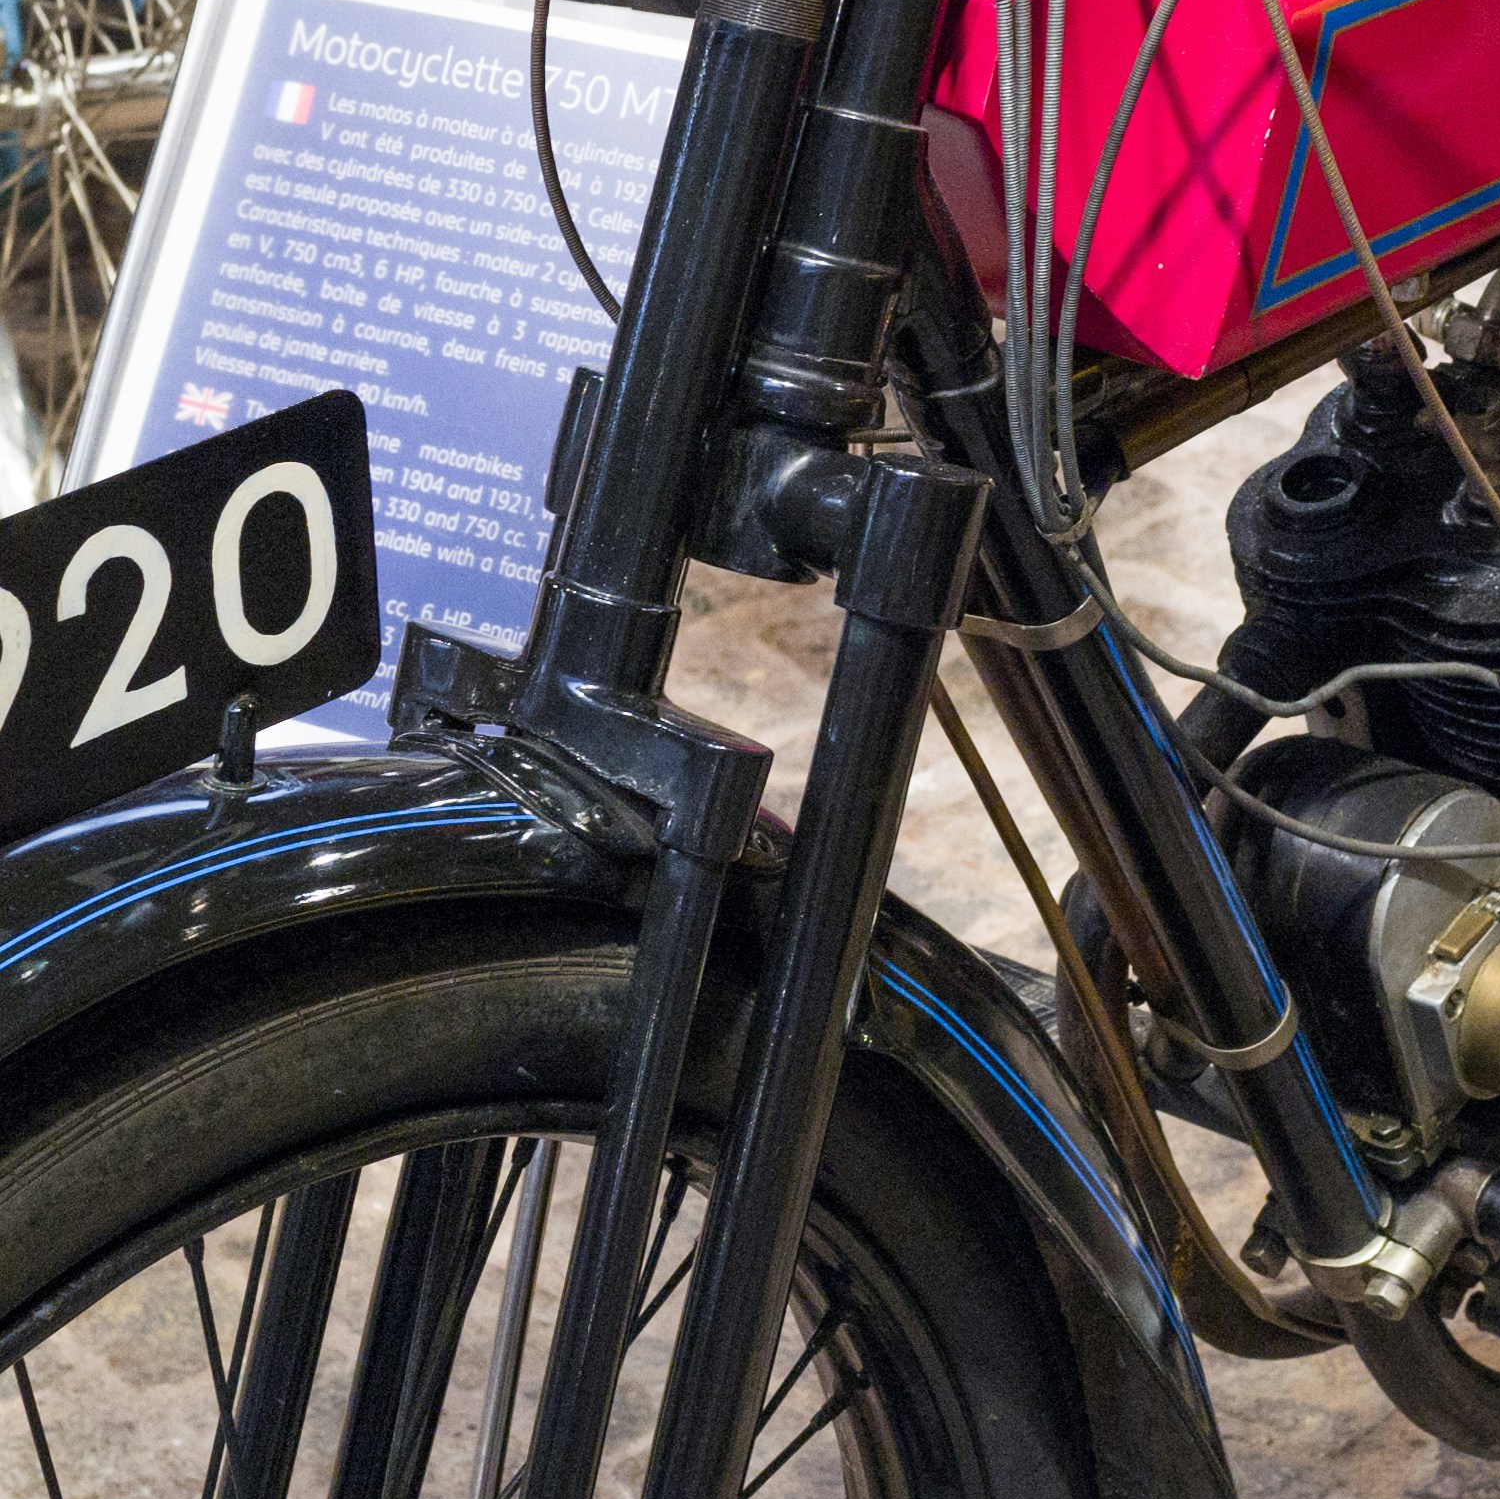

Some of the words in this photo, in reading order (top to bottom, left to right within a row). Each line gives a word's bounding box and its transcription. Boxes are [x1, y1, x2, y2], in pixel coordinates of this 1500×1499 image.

[288, 18, 524, 99] Motocyclette
[545, 65, 610, 114] 750
[321, 121, 335, 141] V
[339, 129, 369, 149] ont
[375, 131, 404, 155] été
[410, 142, 496, 174] produites
[503, 158, 527, 180] de
[590, 175, 602, 195] à
[614, 179, 647, 204] 192
[328, 92, 357, 115] Les
[359, 101, 412, 126] motos
[416, 108, 428, 128] à
[432, 116, 498, 142] moteur
[501, 125, 512, 145] à
[517, 128, 559, 154] dex
[563, 141, 645, 171] cylindres
[244, 173, 272, 192] est
[274, 175, 291, 196] la
[293, 183, 337, 206] seule
[338, 192, 422, 223] proposée
[425, 210, 466, 232] avec
[469, 218, 492, 237] un
[254, 144, 293, 166] avec
[296, 149, 325, 172] des
[327, 156, 415, 190] cylindrées
[418, 173, 442, 195] de
[445, 178, 481, 203] 330
[484, 186, 497, 207] à
[502, 189, 536, 214] 750
[539, 202, 581, 223] c3.
[588, 207, 642, 234] Celle-
[237, 198, 363, 242] Caractéristique
[366, 226, 460, 263] techniques
[473, 252, 539, 278] moteur
[541, 260, 555, 282] 2
[219, 261, 308, 297] renforcée,
[378, 292, 402, 314] de
[413, 303, 475, 330] vitesse
[487, 315, 500, 336] à
[512, 320, 528, 341] 3
[227, 231, 250, 249] en
[259, 235, 274, 259] V,
[283, 239, 318, 264] 750
[322, 252, 366, 278] cm3,
[374, 259, 388, 279] 6
[395, 263, 426, 291] HP,
[435, 270, 503, 303] fourche
[510, 288, 523, 308] à
[530, 296, 617, 329] suspensi
[201, 320, 257, 346] poulie
[259, 330, 282, 351] de
[280, 335, 328, 362] jante
[330, 349, 390, 376] arrière.
[210, 288, 324, 329] transmission
[331, 313, 345, 334] à
[354, 322, 430, 356] courroie,
[442, 337, 487, 365] deux
[494, 348, 547, 378] freins
[195, 346, 257, 377] Vitesse
[258, 364, 344, 392] maximum
[382, 388, 428, 416] km/h.
[401, 467, 445, 494] 1904
[447, 484, 484, 505] and
[488, 488, 535, 521] 1921,
[419, 443, 523, 482] motorbikes
[374, 529, 432, 558] ailable
[437, 545, 475, 567] with
[480, 557, 493, 573] a
[498, 555, 541, 585] facto
[384, 496, 421, 522] 330
[424, 510, 460, 532] and
[464, 515, 500, 541] 750
[503, 530, 527, 548] cc.
[0, 462, 338, 749] 20
[385, 599, 411, 622] cc,
[420, 603, 435, 620] 6
[443, 608, 472, 627] HP
